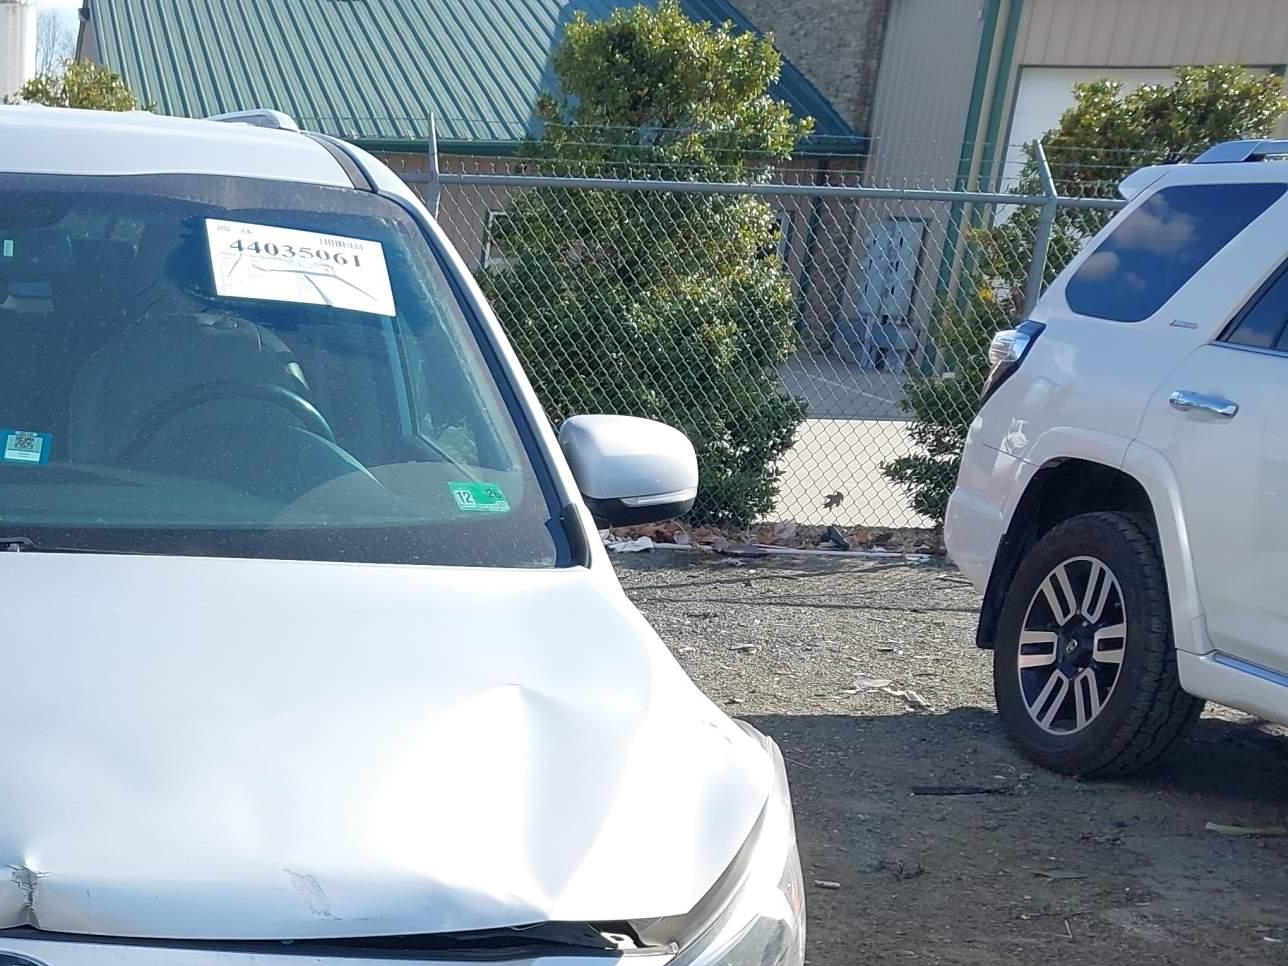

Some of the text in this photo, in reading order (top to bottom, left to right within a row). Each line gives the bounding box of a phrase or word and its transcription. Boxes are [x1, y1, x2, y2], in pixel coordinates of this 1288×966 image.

[229, 237, 363, 268] 44035061
[456, 488, 502, 504] 12 26
